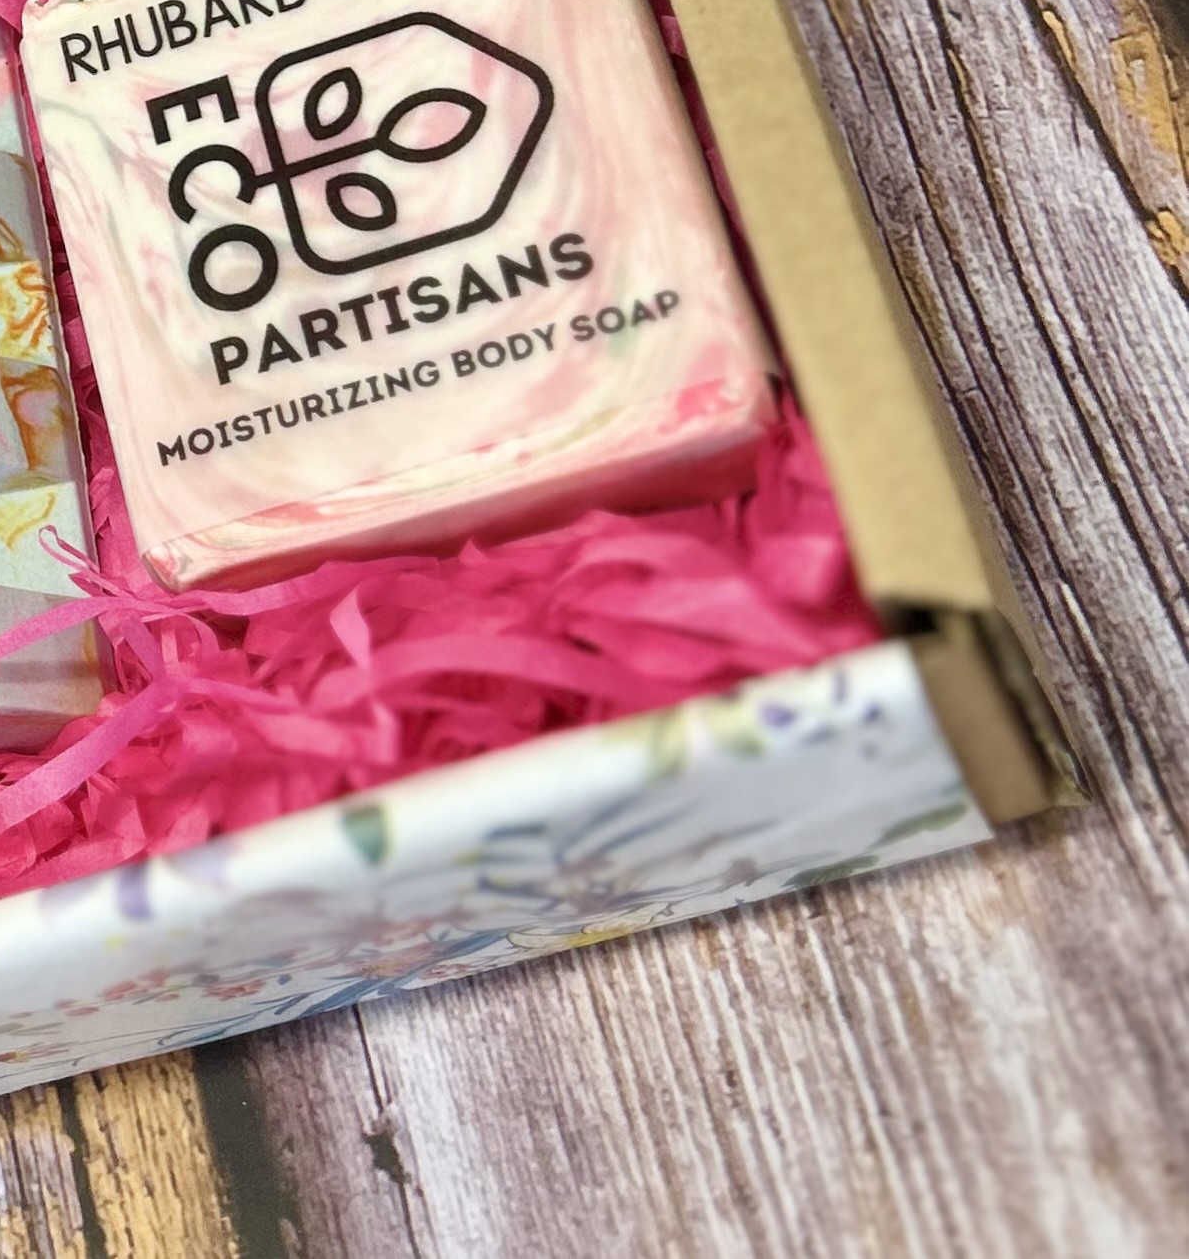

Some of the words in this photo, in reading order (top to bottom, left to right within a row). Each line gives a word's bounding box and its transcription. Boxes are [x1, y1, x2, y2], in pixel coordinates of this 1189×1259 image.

[145, 74, 279, 312] ECO
[156, 360, 441, 467] MOISTURIZING
[450, 323, 557, 378] BODY
[569, 289, 680, 343] SOAP
[209, 233, 595, 386] PARTISANS
